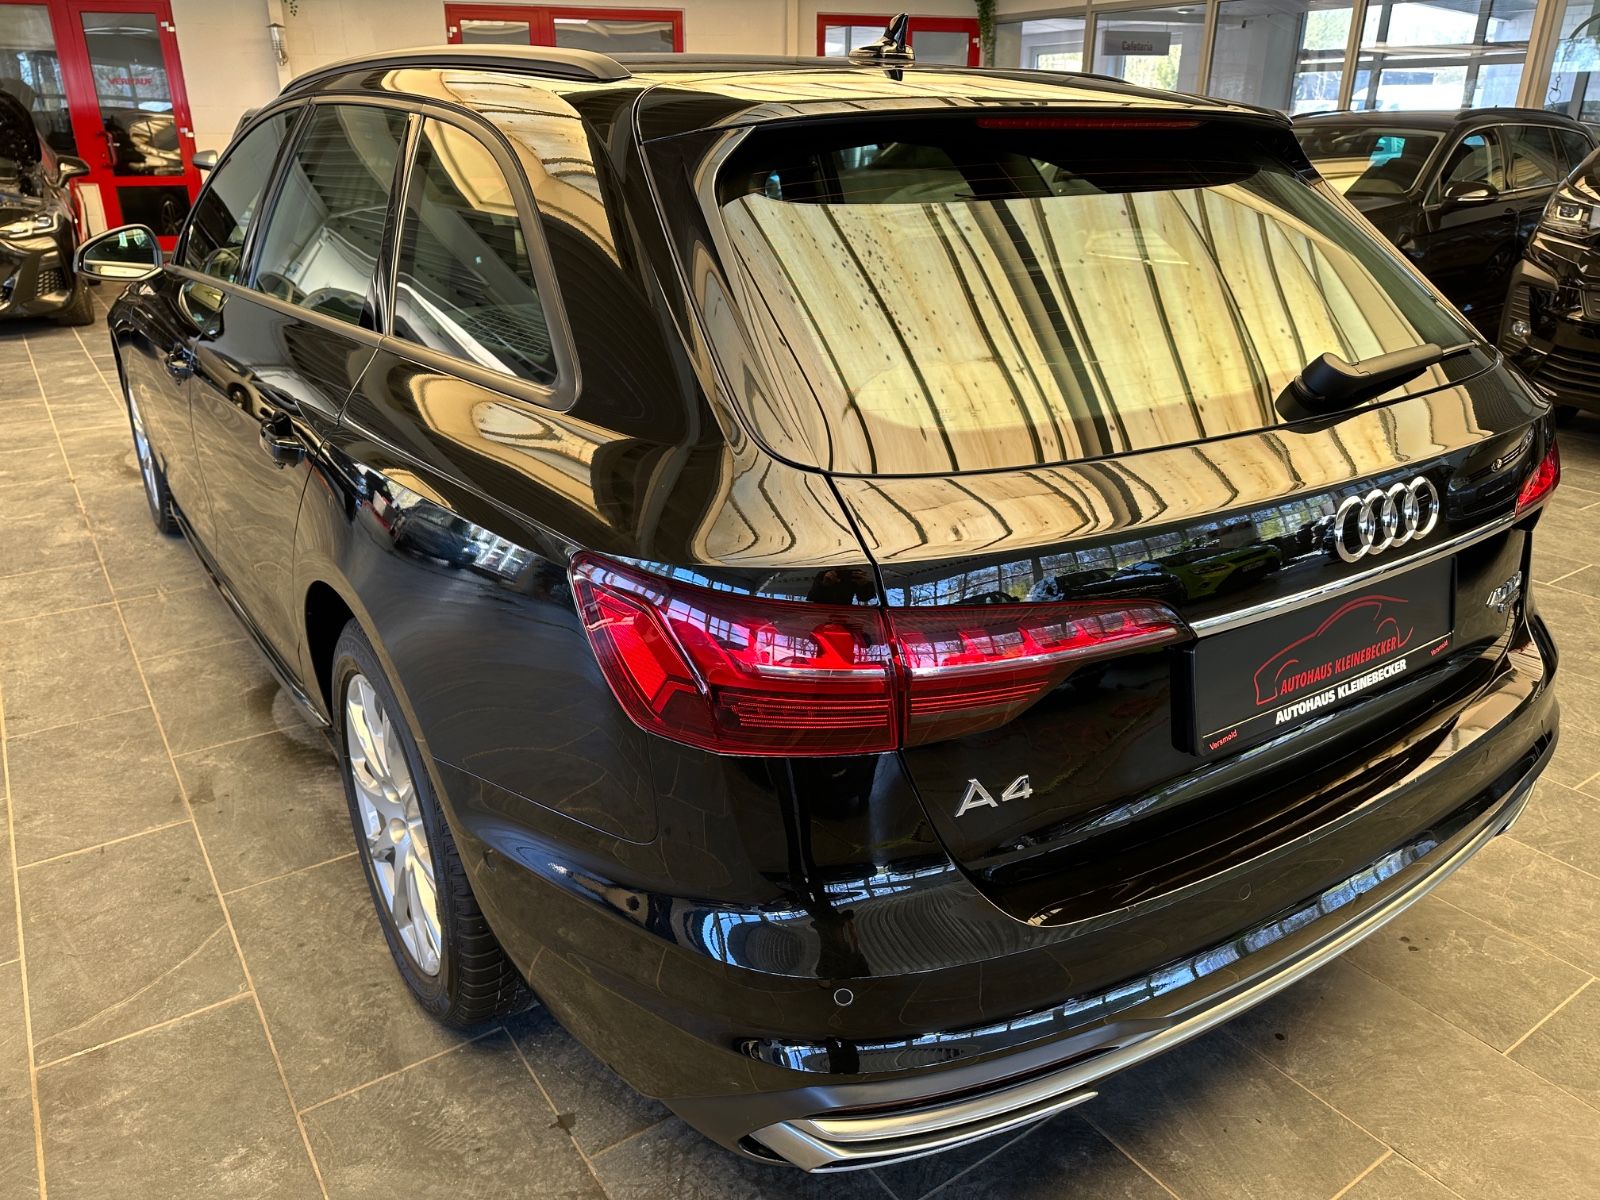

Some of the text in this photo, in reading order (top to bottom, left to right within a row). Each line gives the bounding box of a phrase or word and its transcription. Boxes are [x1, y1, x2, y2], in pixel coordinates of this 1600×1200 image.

[1275, 658, 1407, 724] AUTOHAUS KLEINEBECKER
[1280, 636, 1397, 695] AUTOHAUS KLEINEBECKER
[954, 774, 1033, 818] A4
